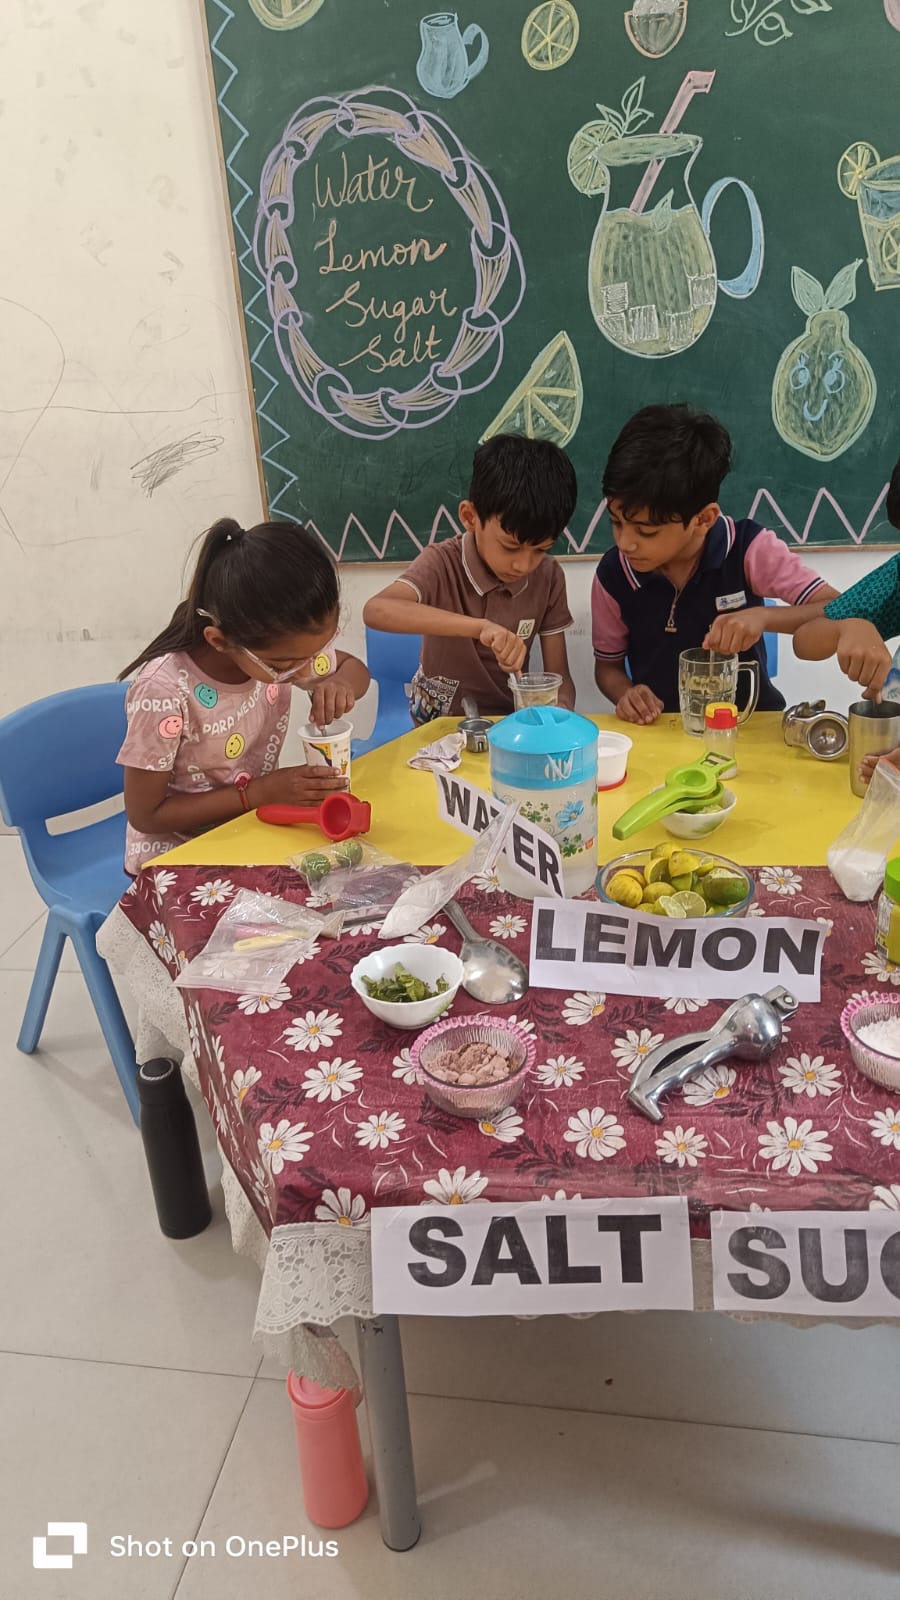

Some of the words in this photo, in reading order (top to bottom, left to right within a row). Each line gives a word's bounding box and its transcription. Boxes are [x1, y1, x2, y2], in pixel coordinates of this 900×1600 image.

[315, 151, 434, 212] Water
[314, 219, 448, 275] Lemon
[325, 280, 458, 343] Sugar
[338, 324, 442, 373] Salt
[202, 716, 235, 736] PARA
[439, 774, 563, 898] WAER
[535, 908, 821, 976] LEMON
[407, 1213, 662, 1288] SALT
